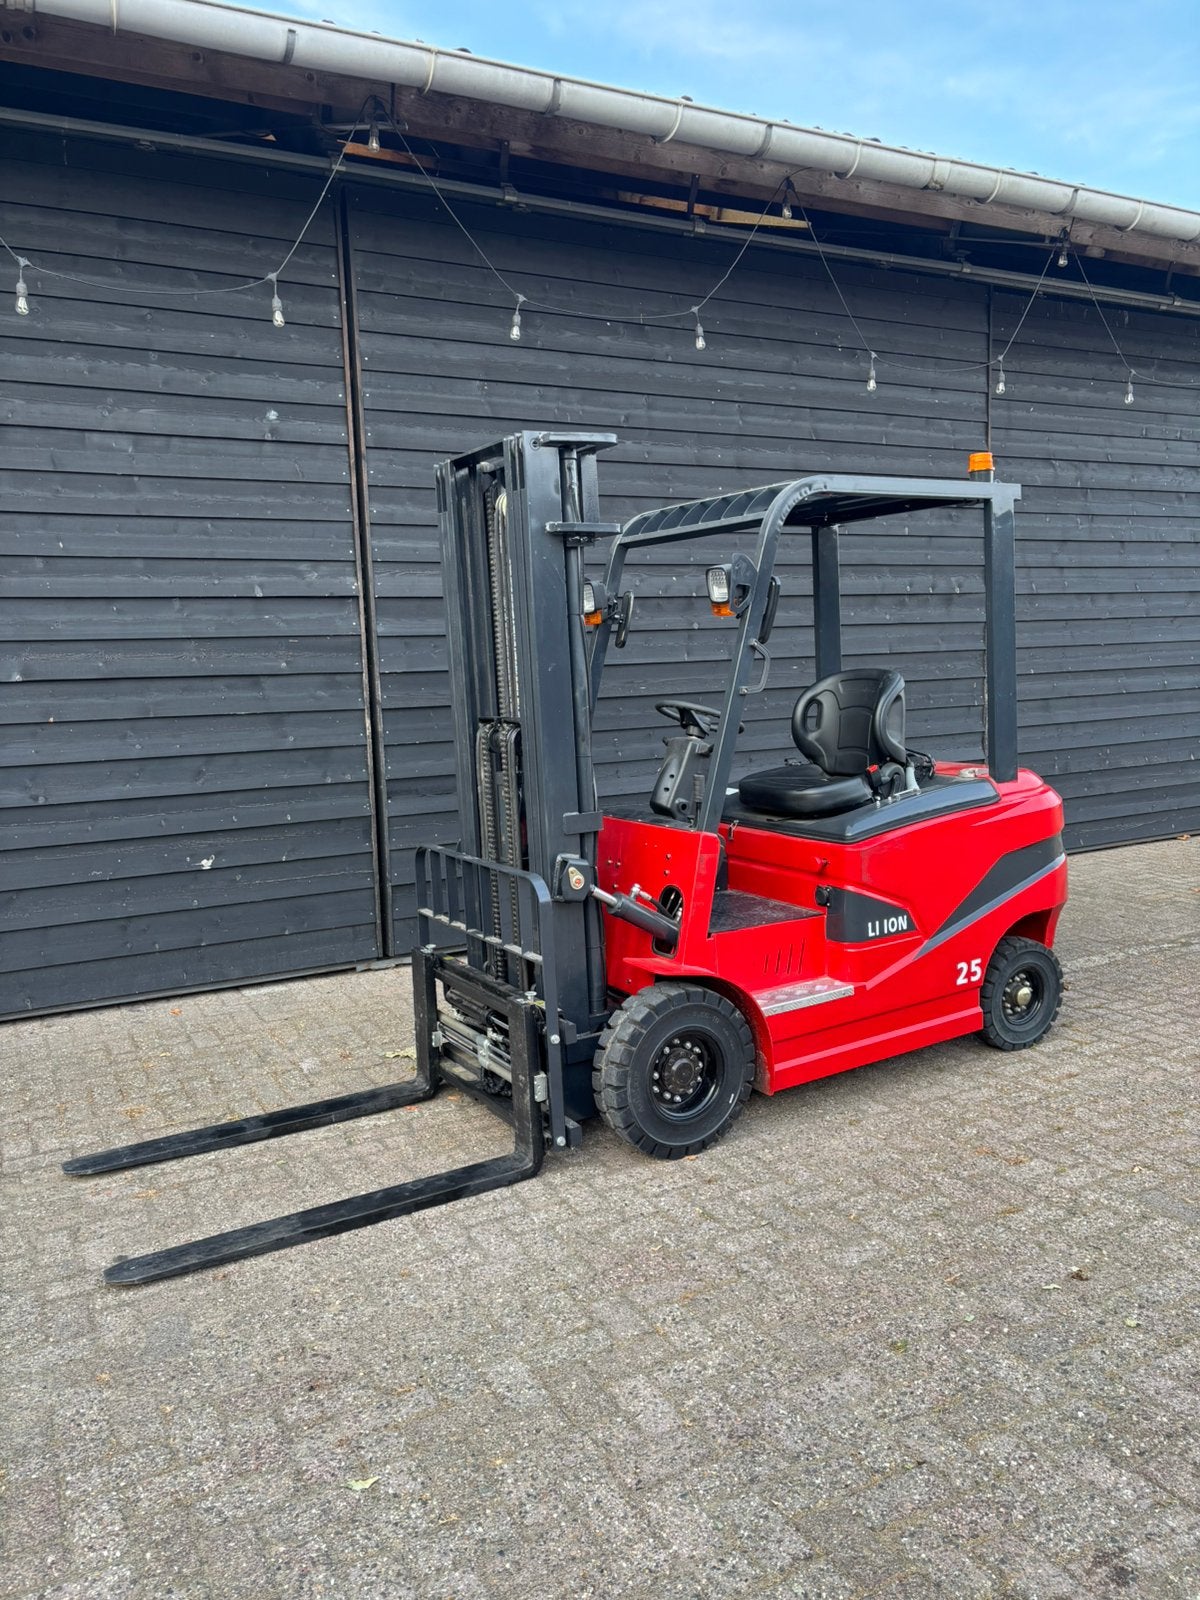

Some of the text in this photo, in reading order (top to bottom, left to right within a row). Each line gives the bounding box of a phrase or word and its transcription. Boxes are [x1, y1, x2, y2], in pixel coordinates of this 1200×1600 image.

[867, 914, 908, 937] LI ION
[956, 958, 982, 986] 25
